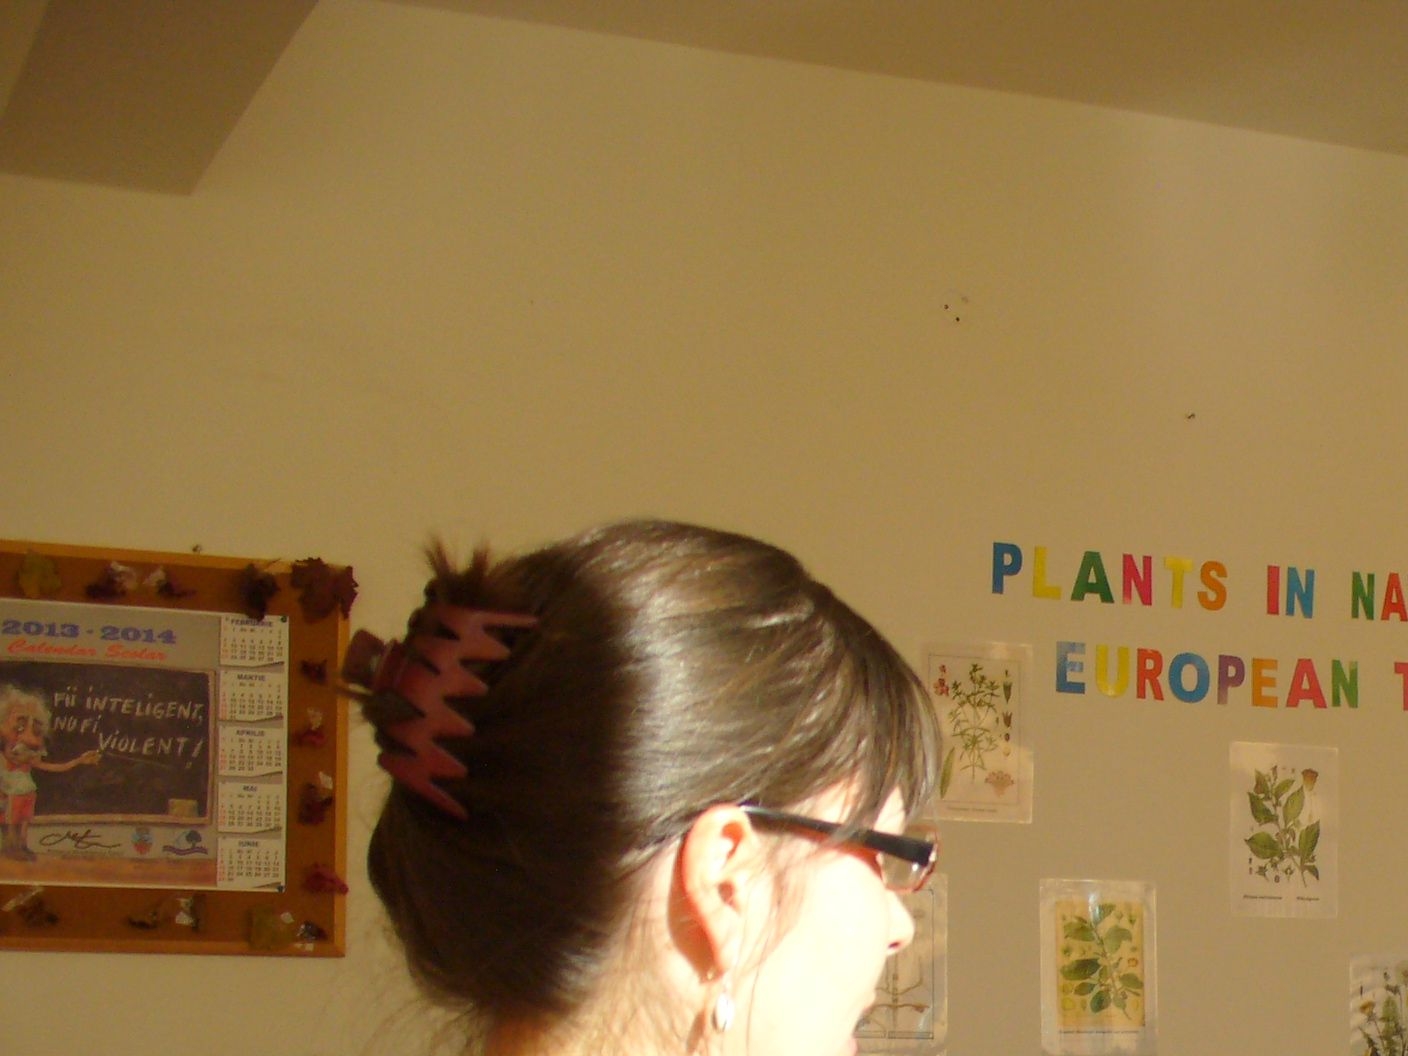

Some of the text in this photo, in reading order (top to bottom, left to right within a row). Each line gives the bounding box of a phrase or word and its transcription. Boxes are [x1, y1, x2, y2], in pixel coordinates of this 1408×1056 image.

[991, 541, 1228, 611] PLANTS
[1266, 564, 1316, 619] IN
[2, 619, 80, 638] 2013
[101, 625, 177, 644] 2014
[1055, 641, 1359, 709] EUROPEAN
